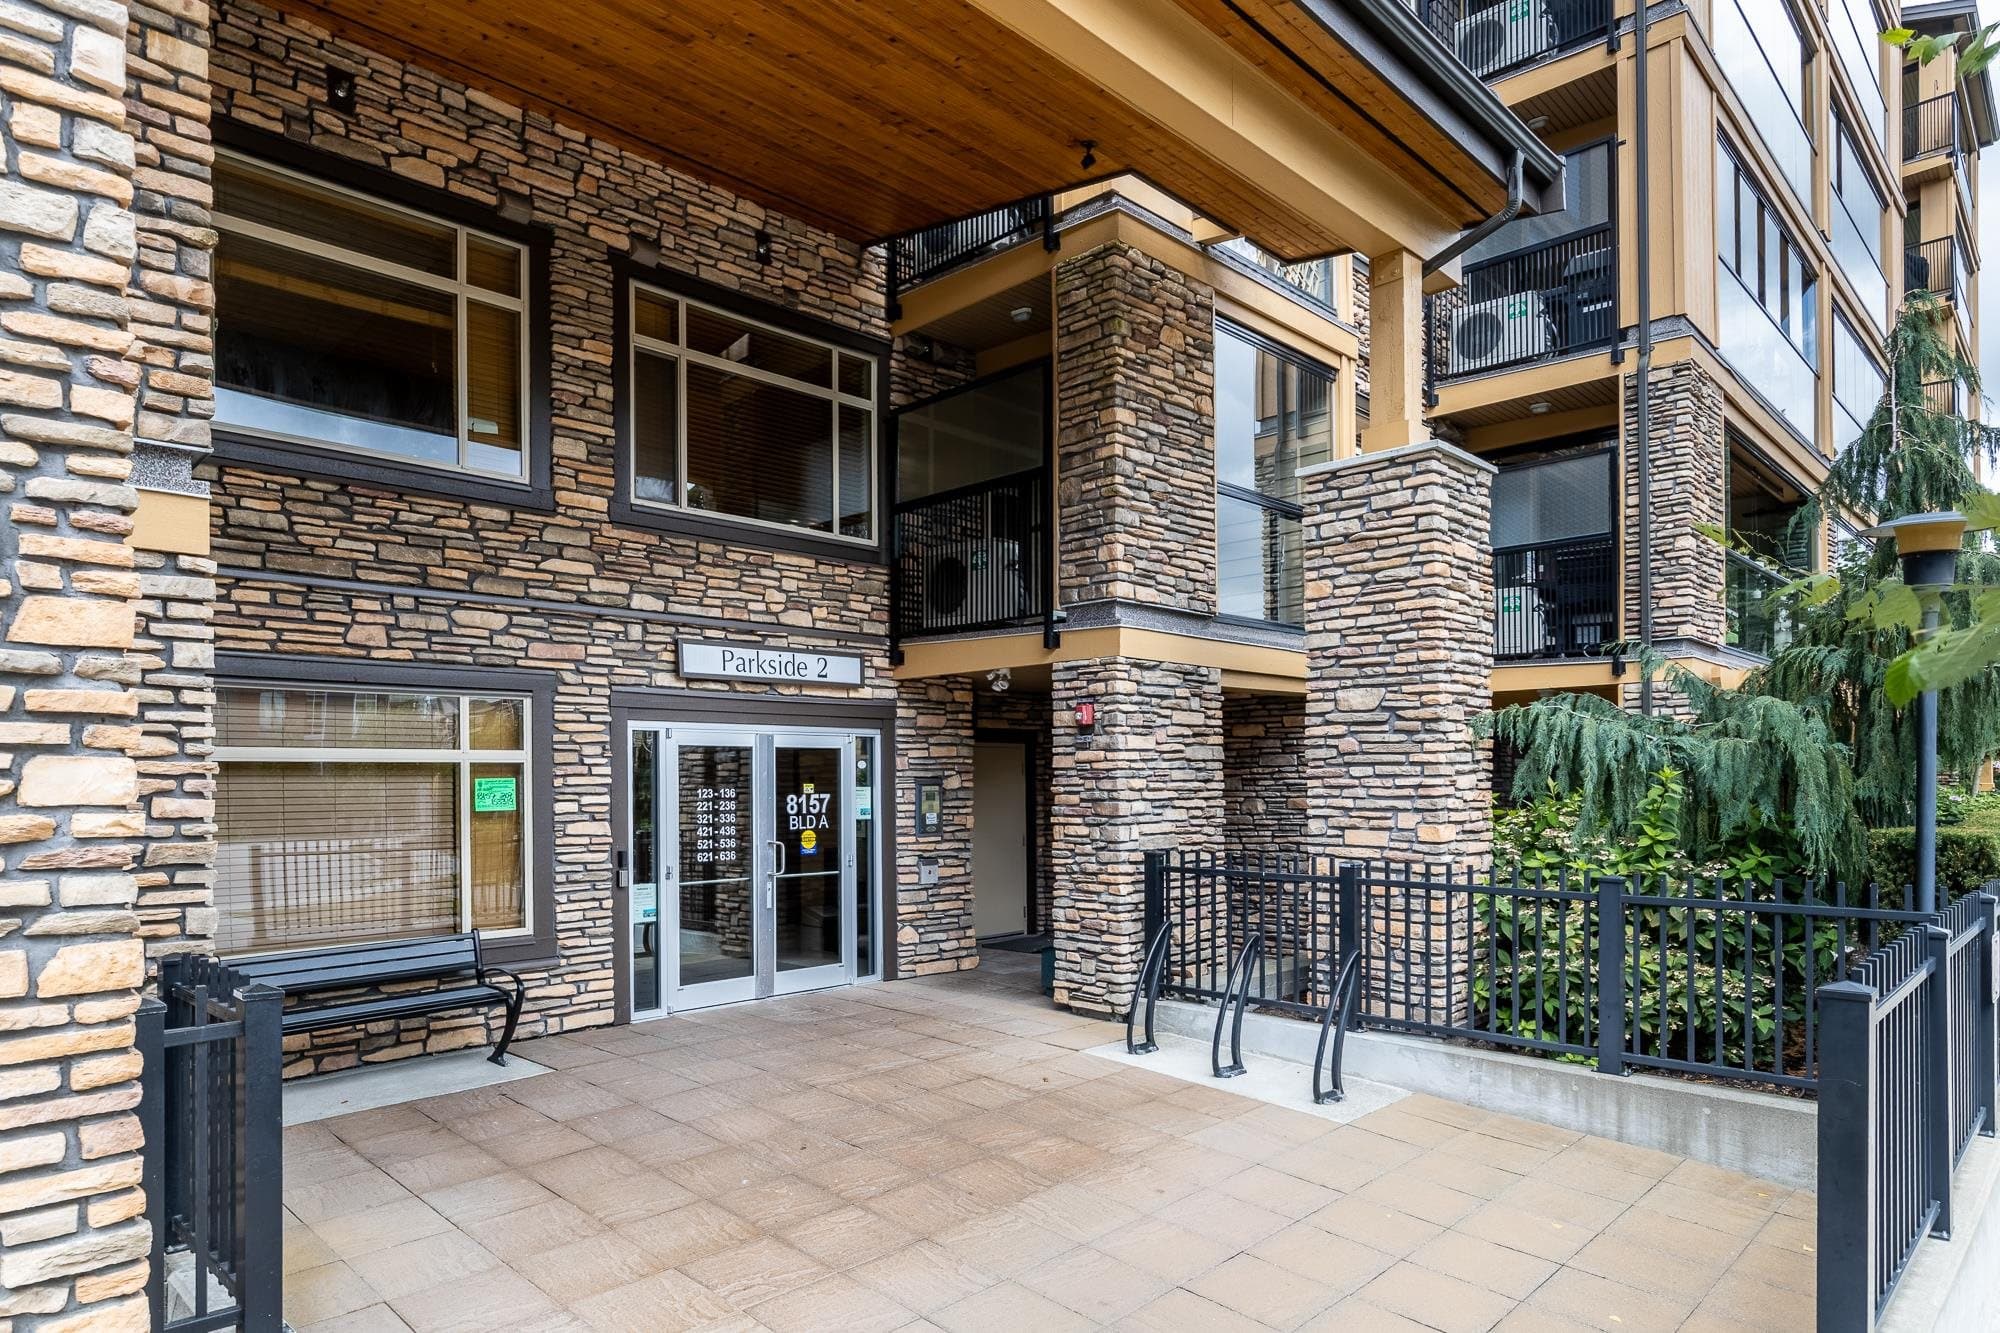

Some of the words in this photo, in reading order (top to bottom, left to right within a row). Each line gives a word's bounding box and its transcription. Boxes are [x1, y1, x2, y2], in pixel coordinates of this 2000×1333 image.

[722, 649, 808, 678] Parkside
[817, 657, 828, 679] 2
[786, 793, 831, 815] 8157
[789, 815, 816, 830] BLD
[818, 814, 829, 829] A
